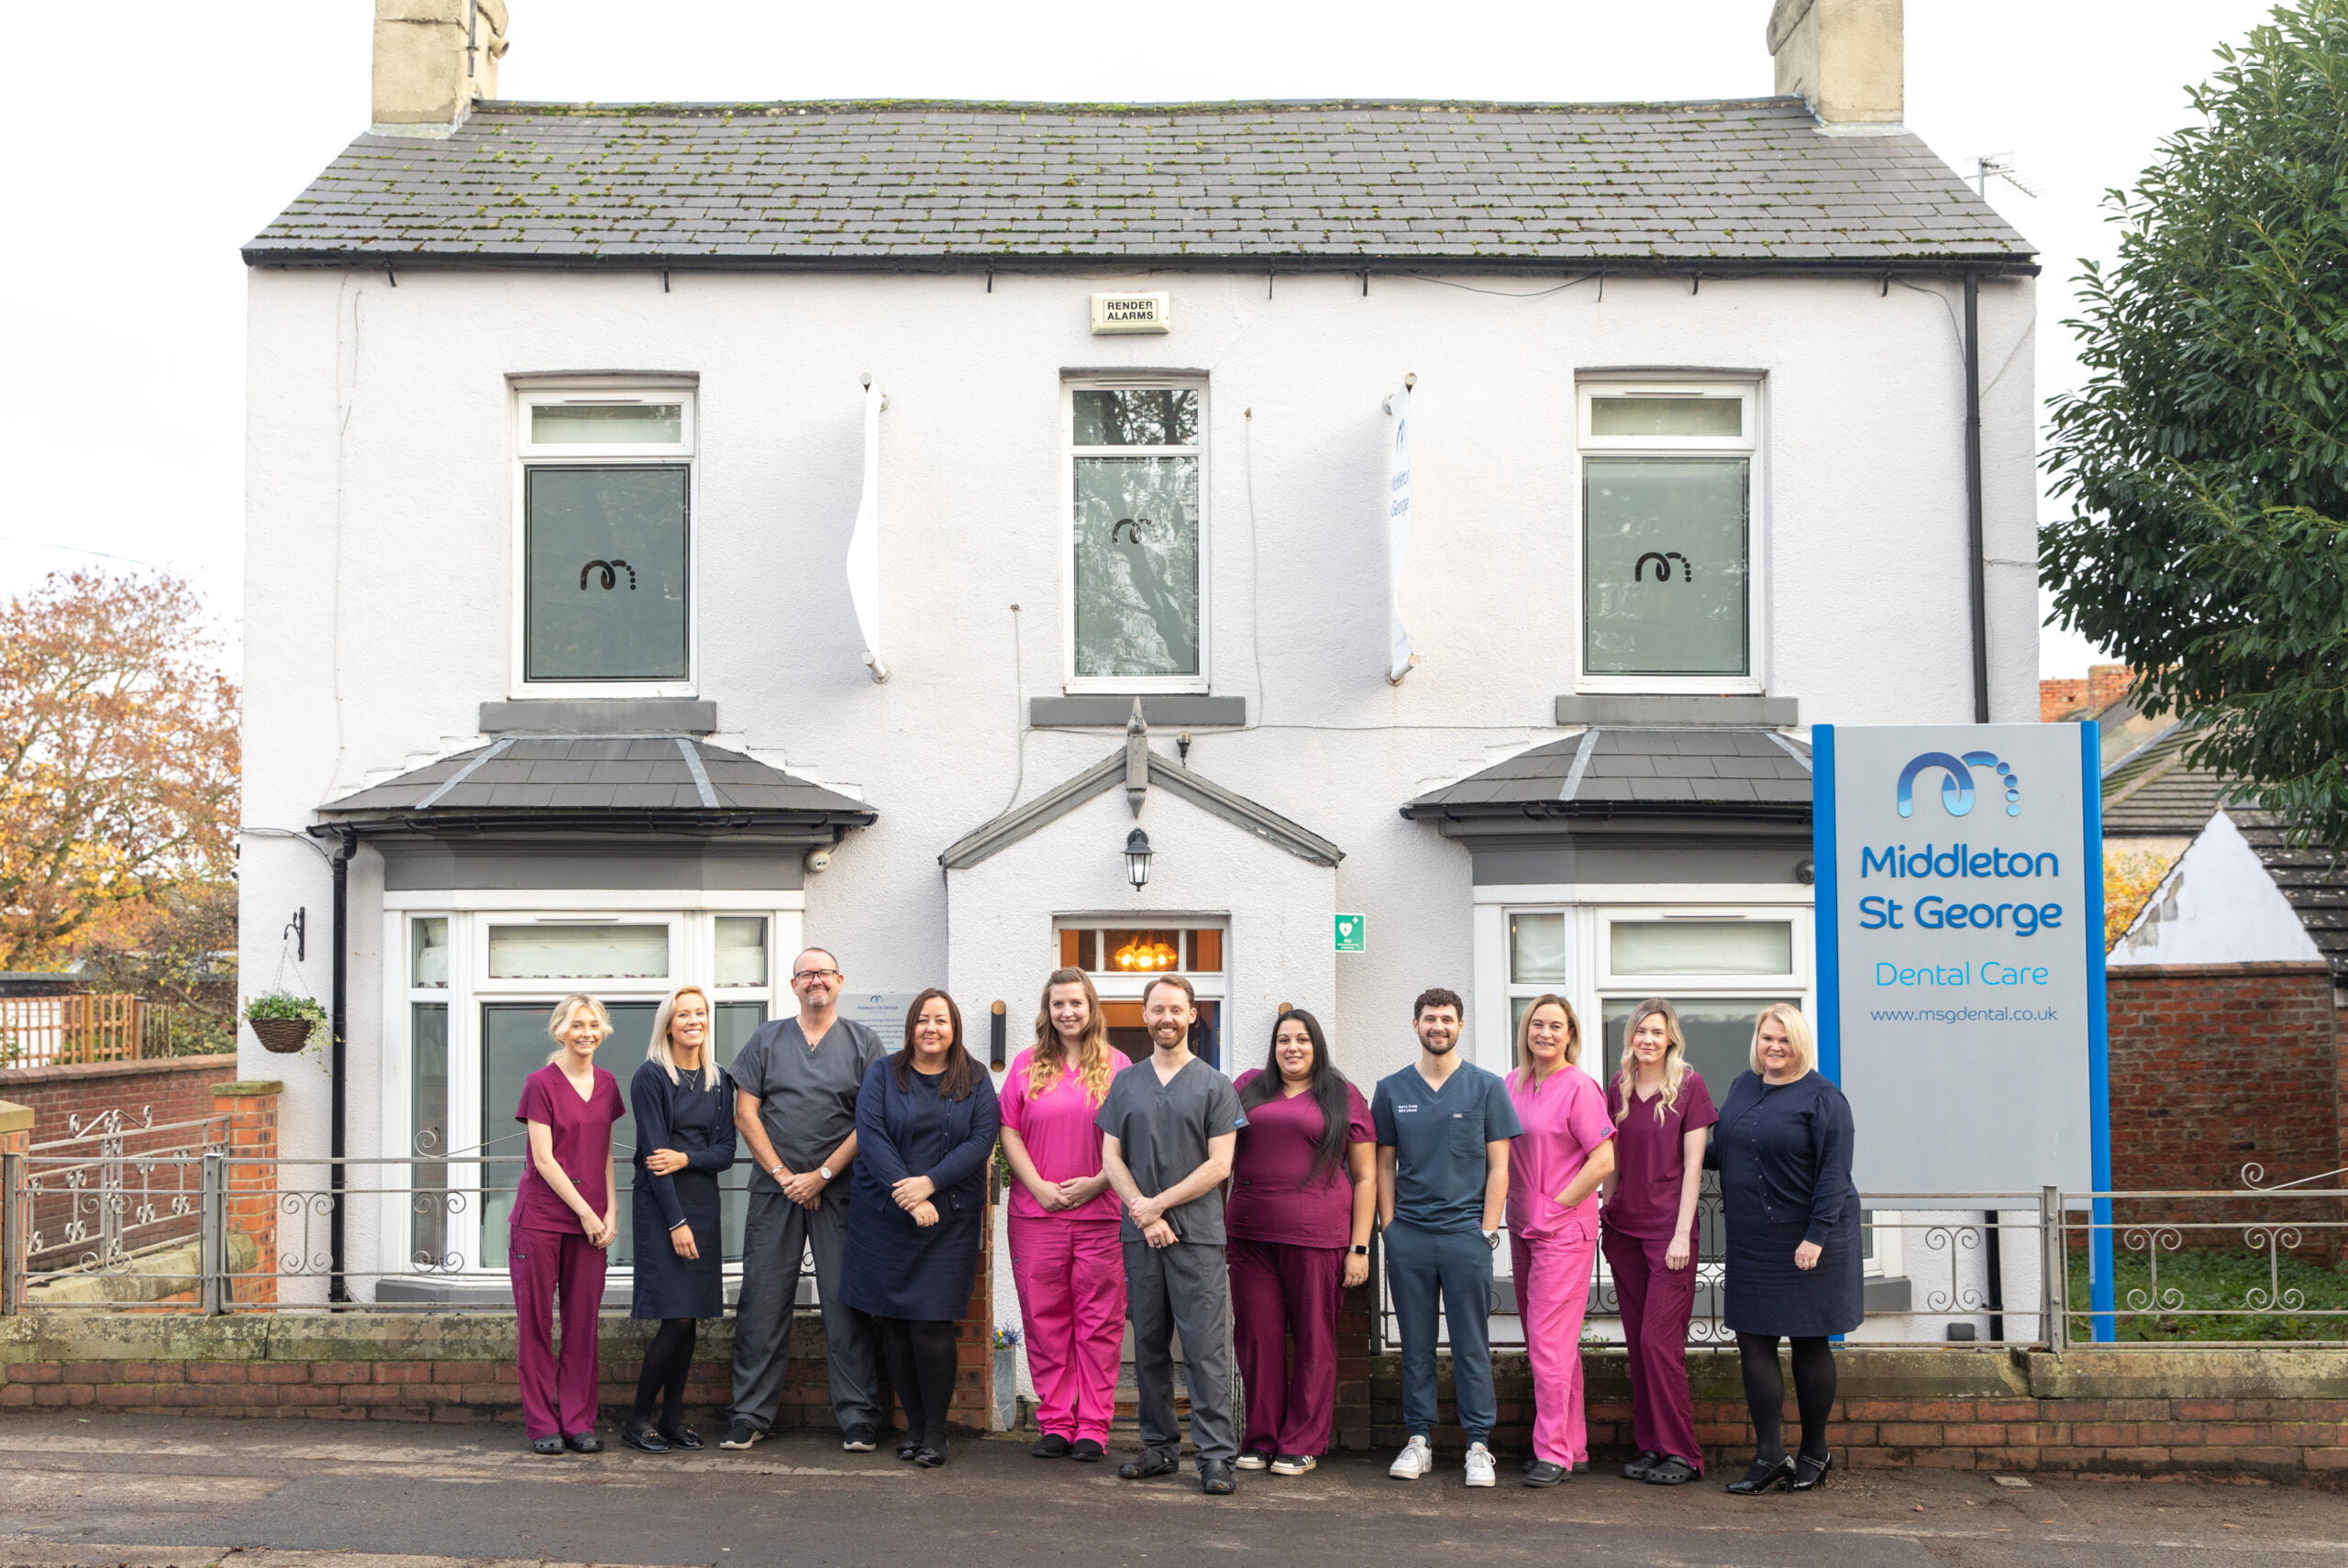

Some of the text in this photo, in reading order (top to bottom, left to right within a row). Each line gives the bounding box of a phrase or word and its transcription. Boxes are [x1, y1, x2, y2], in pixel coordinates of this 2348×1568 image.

[1107, 301, 1153, 310] RENDER
[1107, 311, 1154, 320] ALARMS
[1861, 843, 2060, 878] Middleton
[1858, 895, 2064, 937] St George
[1875, 960, 2050, 987] Dental Care
[1870, 1006, 2058, 1025] www.msgdental.co.uk
